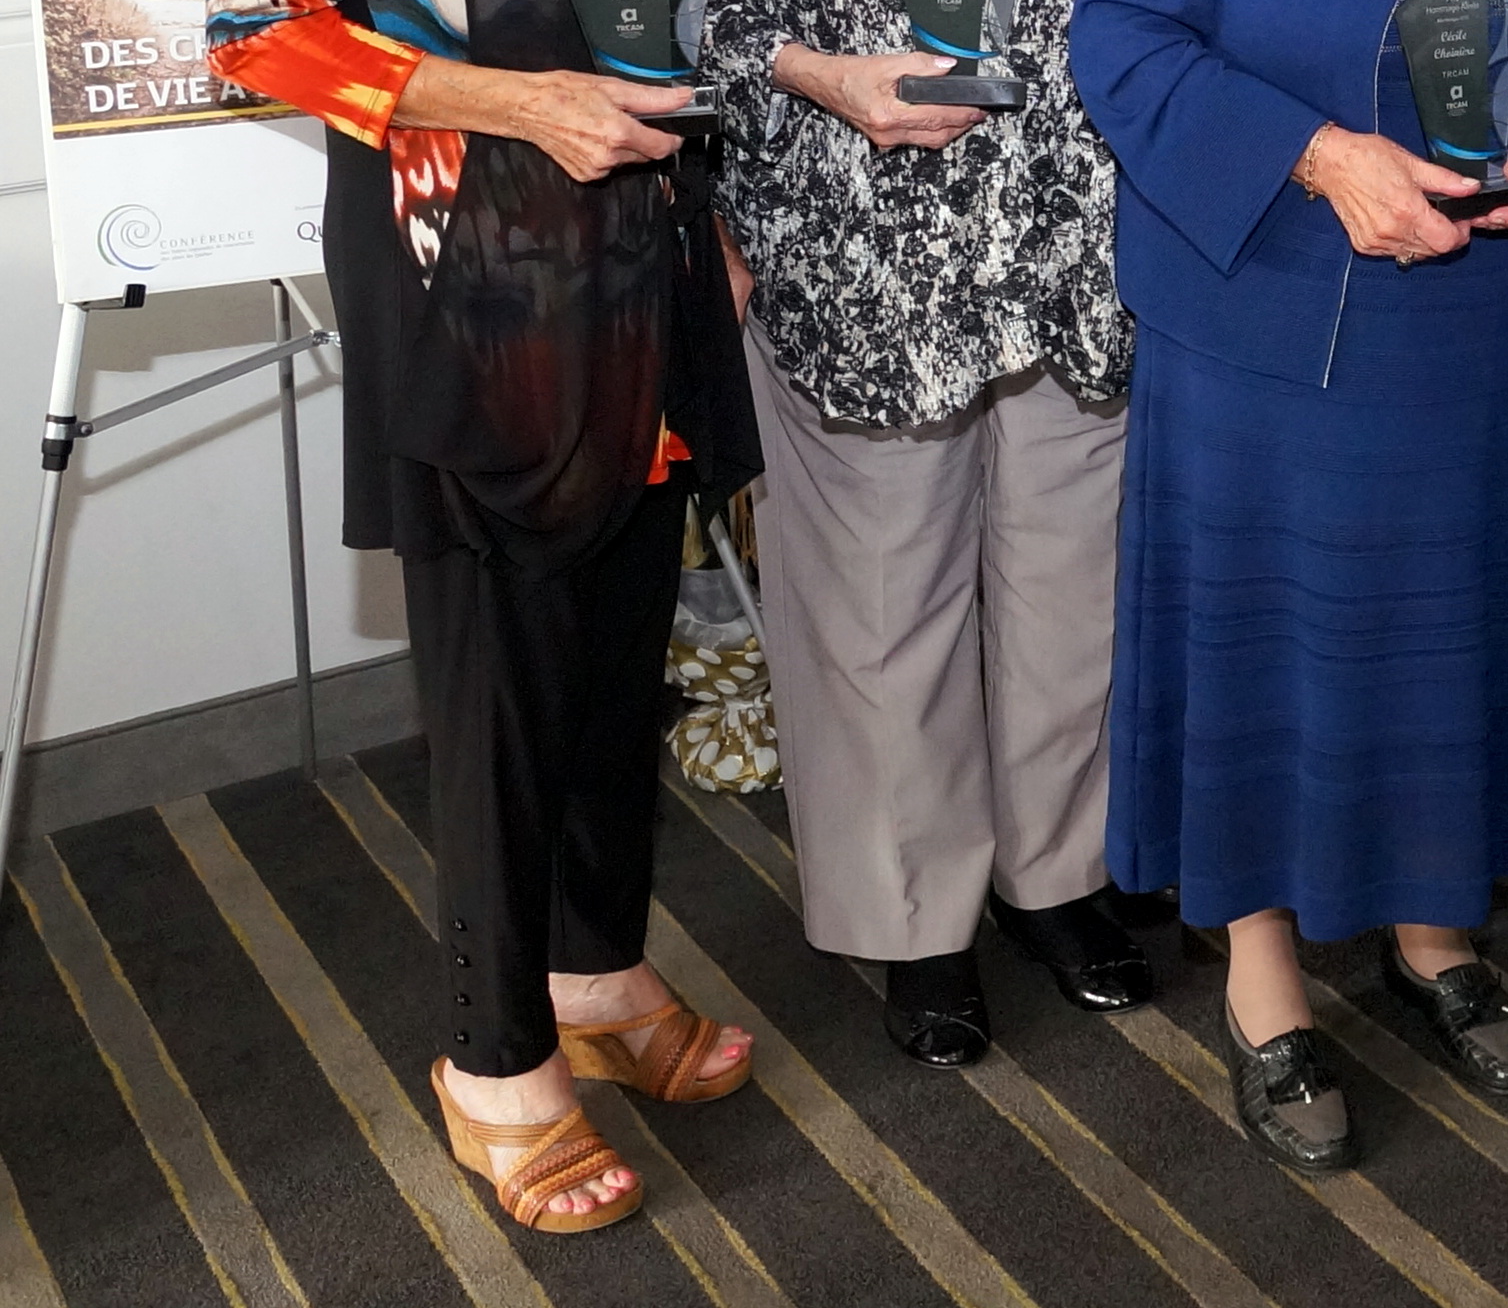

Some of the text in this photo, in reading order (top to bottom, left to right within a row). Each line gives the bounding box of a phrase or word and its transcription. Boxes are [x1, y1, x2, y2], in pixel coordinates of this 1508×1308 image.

[81, 38, 159, 69] DES
[84, 83, 139, 113] DE
[147, 76, 211, 108] VIE
